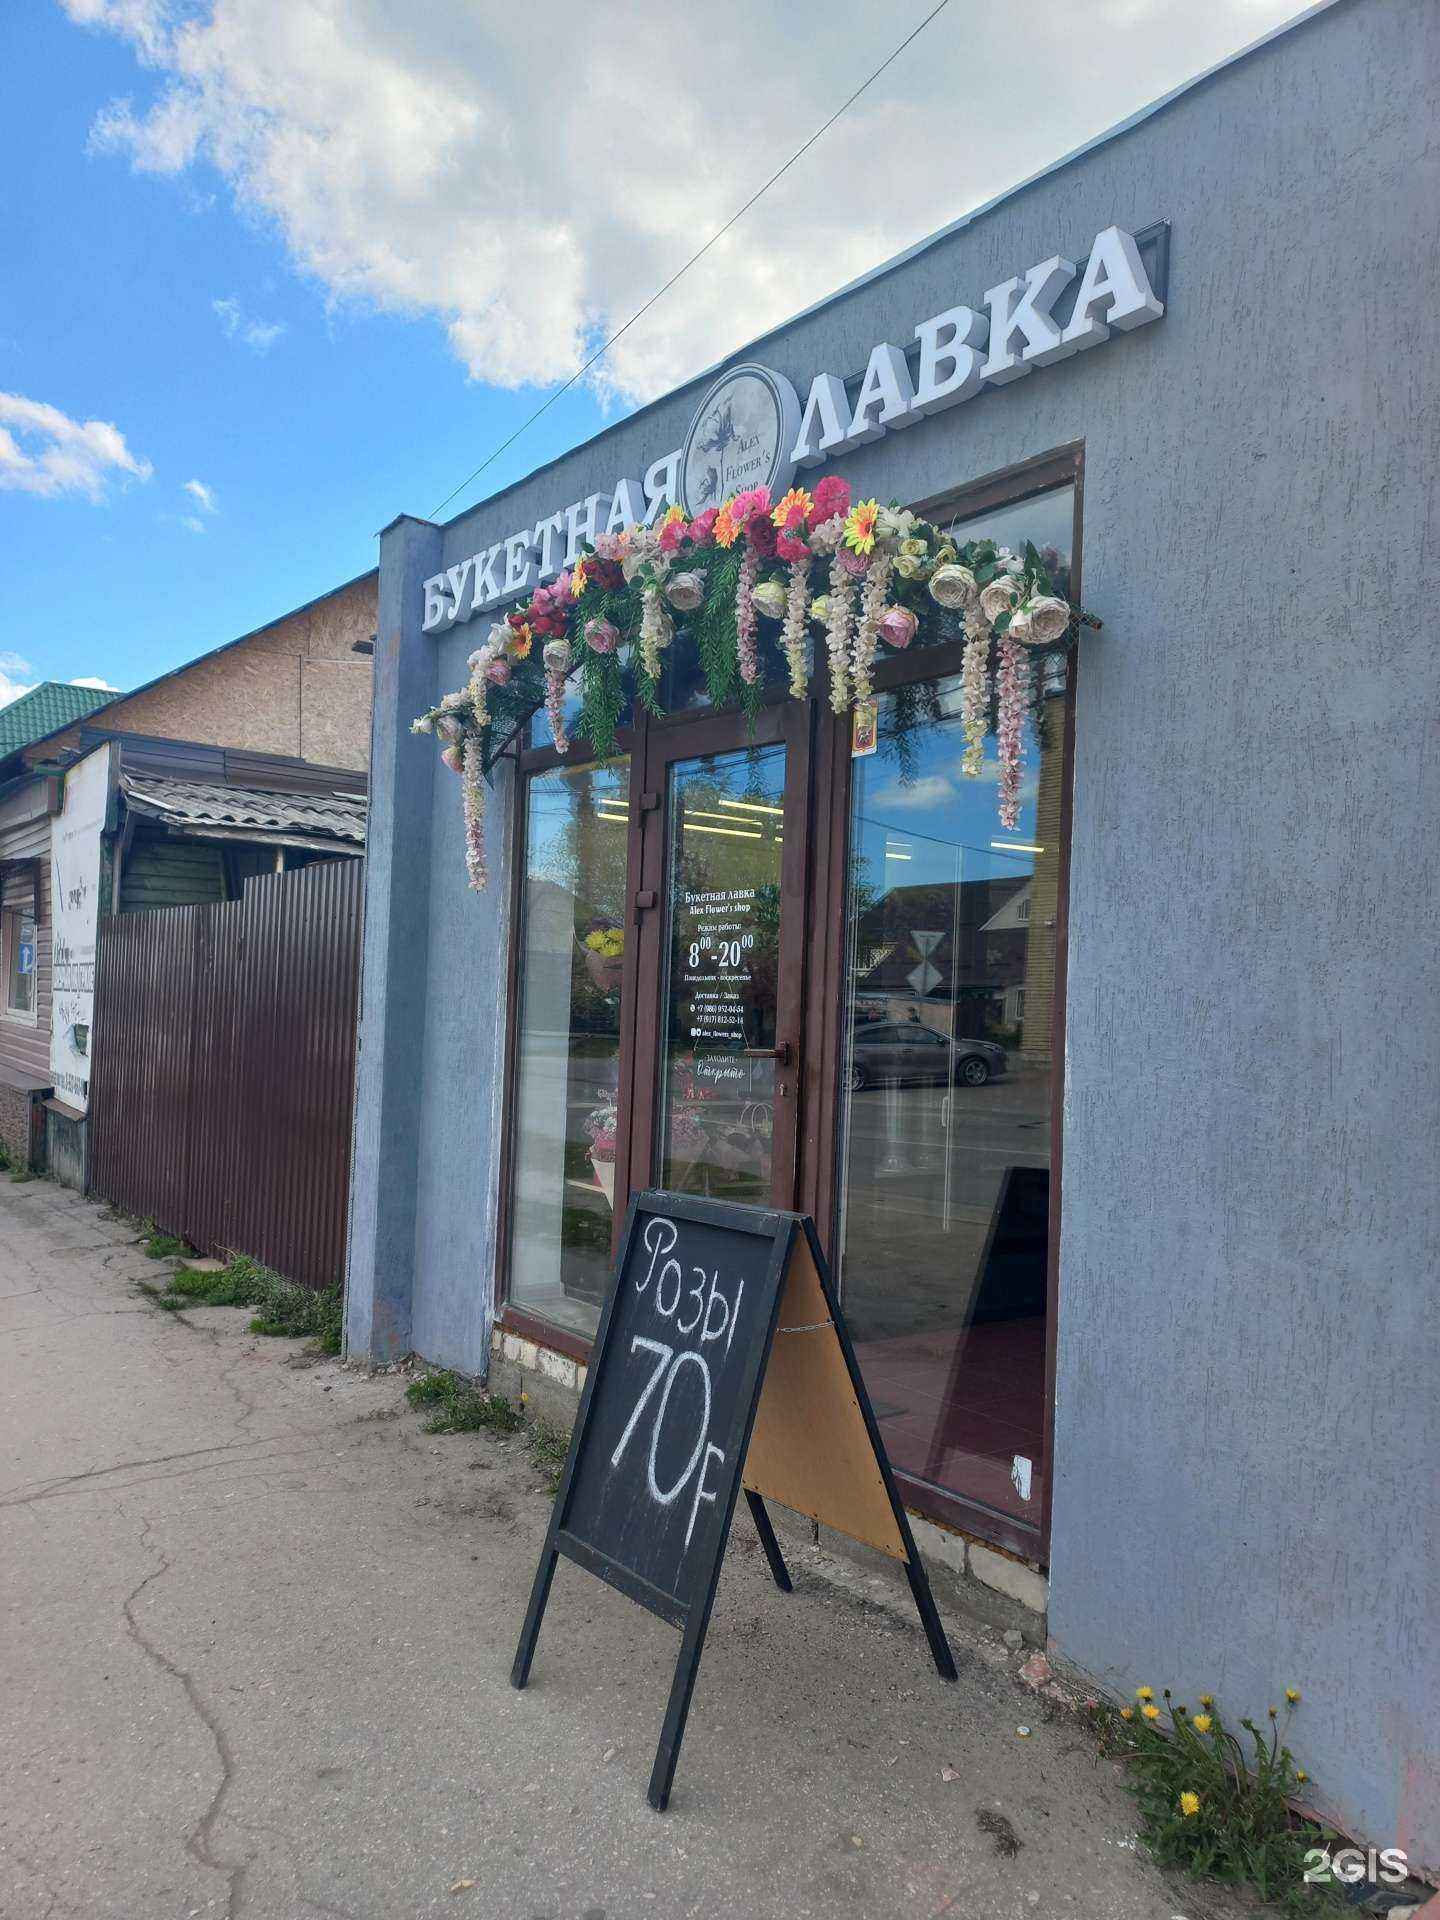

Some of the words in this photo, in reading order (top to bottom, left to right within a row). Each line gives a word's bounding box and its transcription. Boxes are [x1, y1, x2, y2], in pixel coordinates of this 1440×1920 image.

[421, 449, 683, 633] БУКЕТНАЯ
[790, 225, 1163, 465] ЛАВКА
[737, 433, 760, 455] ALEX
[685, 891, 726, 905] Букетная
[689, 905, 704, 915] Alex
[705, 903, 733, 914] Flower's
[734, 902, 751, 913] shop
[635, 1216, 746, 1362] Розы
